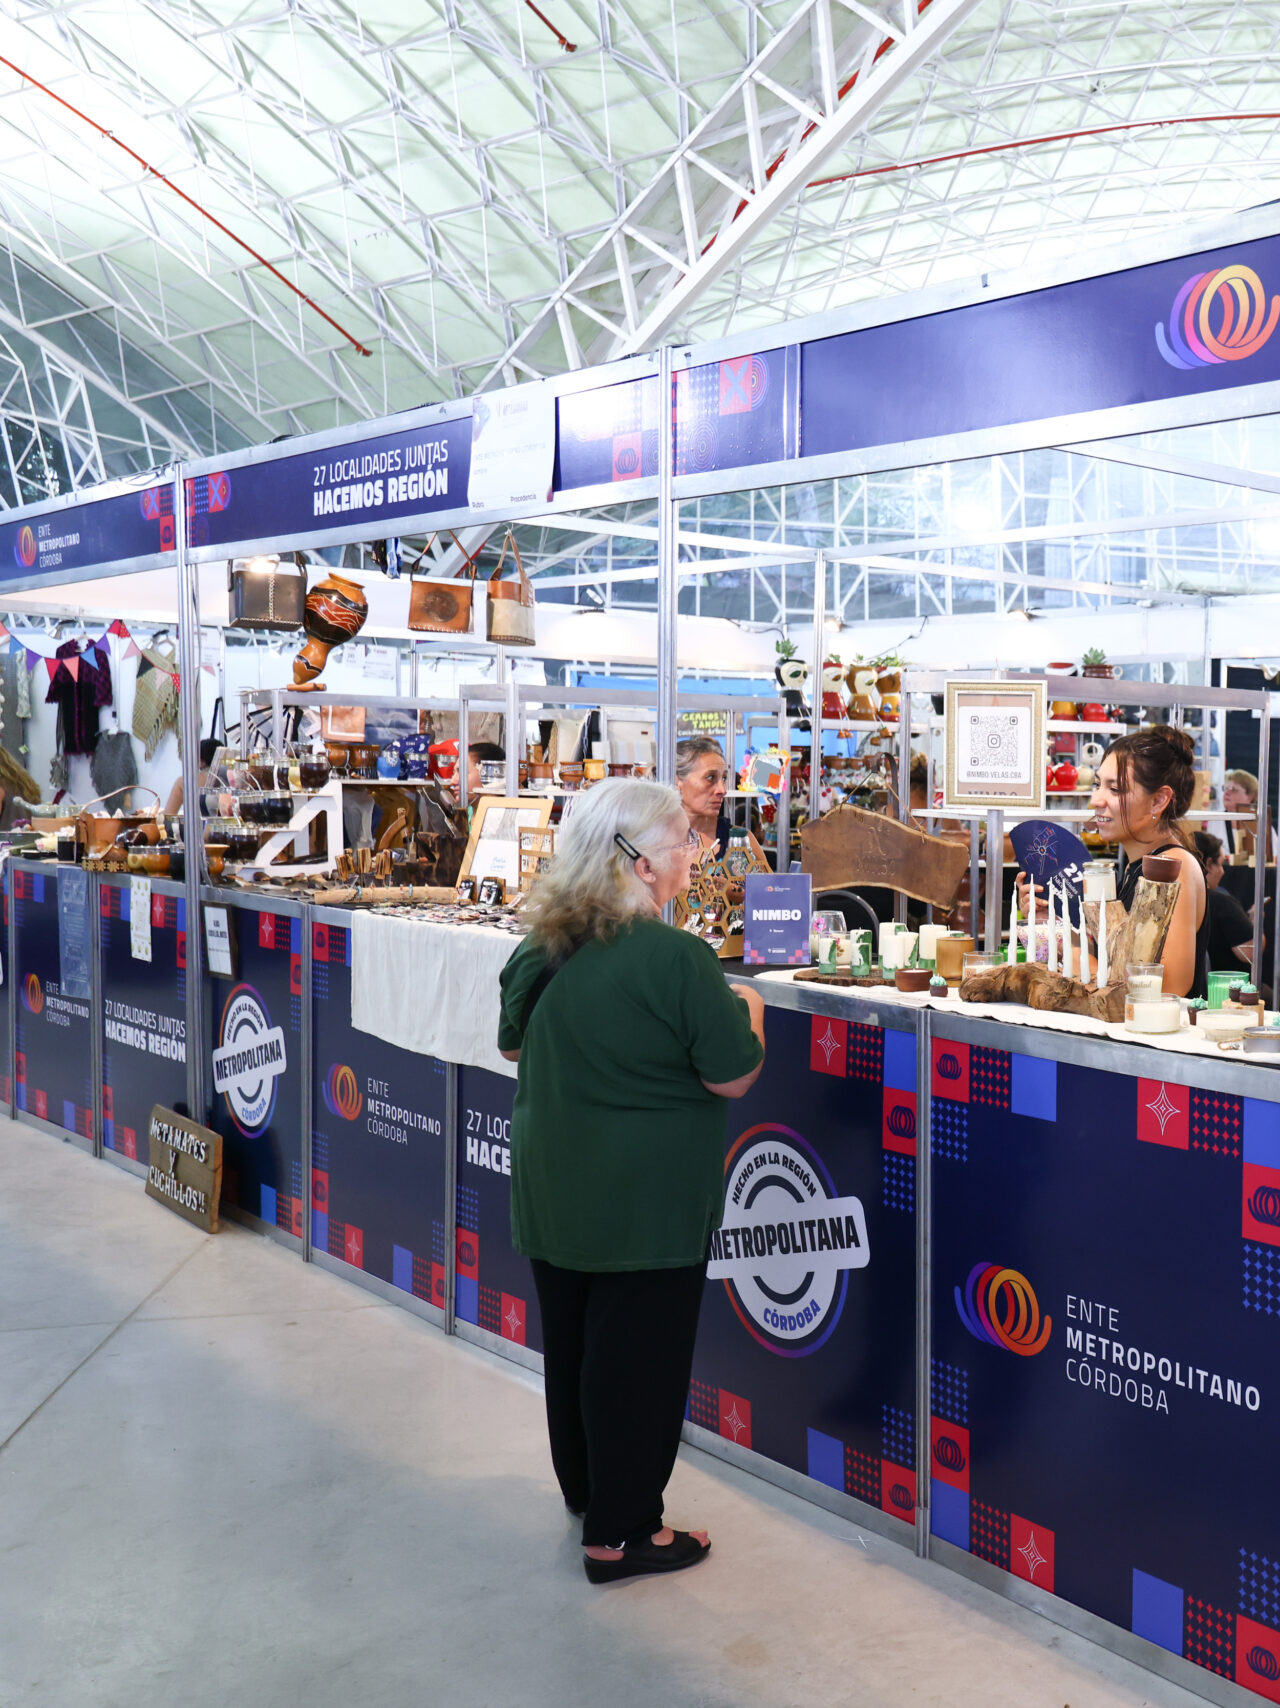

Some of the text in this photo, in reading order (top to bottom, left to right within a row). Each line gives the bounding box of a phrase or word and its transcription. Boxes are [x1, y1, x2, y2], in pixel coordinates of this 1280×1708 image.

[313, 466, 327, 487] 27
[329, 449, 401, 483] LOCALIDADES
[405, 440, 448, 469] JUNTAS
[313, 463, 448, 516] HACEMOS REGIÓN
[38, 524, 51, 537] ENTE
[38, 533, 80, 552] METROPOLITANO
[39, 552, 62, 568] CÓRDOBA
[1063, 862, 1084, 883] 27
[752, 909, 802, 921] NIMBO
[46, 981, 60, 995] ENTE
[46, 996, 90, 1018] METROPOLITANO
[46, 1011, 70, 1026] CÓRDOBA
[105, 999, 186, 1037] 27 LOCALIDADES JUNTAS
[105, 1019, 186, 1063] HACEMOS REGIÓN
[226, 1010, 238, 1041] HECHO
[215, 1038, 283, 1081] METROPOLITANA
[367, 1077, 389, 1098] ENTE
[242, 1097, 267, 1121] CÓRDOBA
[367, 1098, 441, 1136] METROPOLITANO
[466, 1109, 482, 1132] 27
[367, 1116, 408, 1145] CÓRDOBA
[466, 1136, 511, 1176] HACE
[732, 1152, 817, 1205] HECHO EN LA REGIÓN
[708, 1215, 861, 1262] METROPOLITANA
[763, 1299, 821, 1331] CÓRDOBA
[1066, 1295, 1120, 1332] ENTE
[1066, 1326, 1260, 1411] METROPOLITANO
[1066, 1356, 1169, 1415] CÓRDOBA
